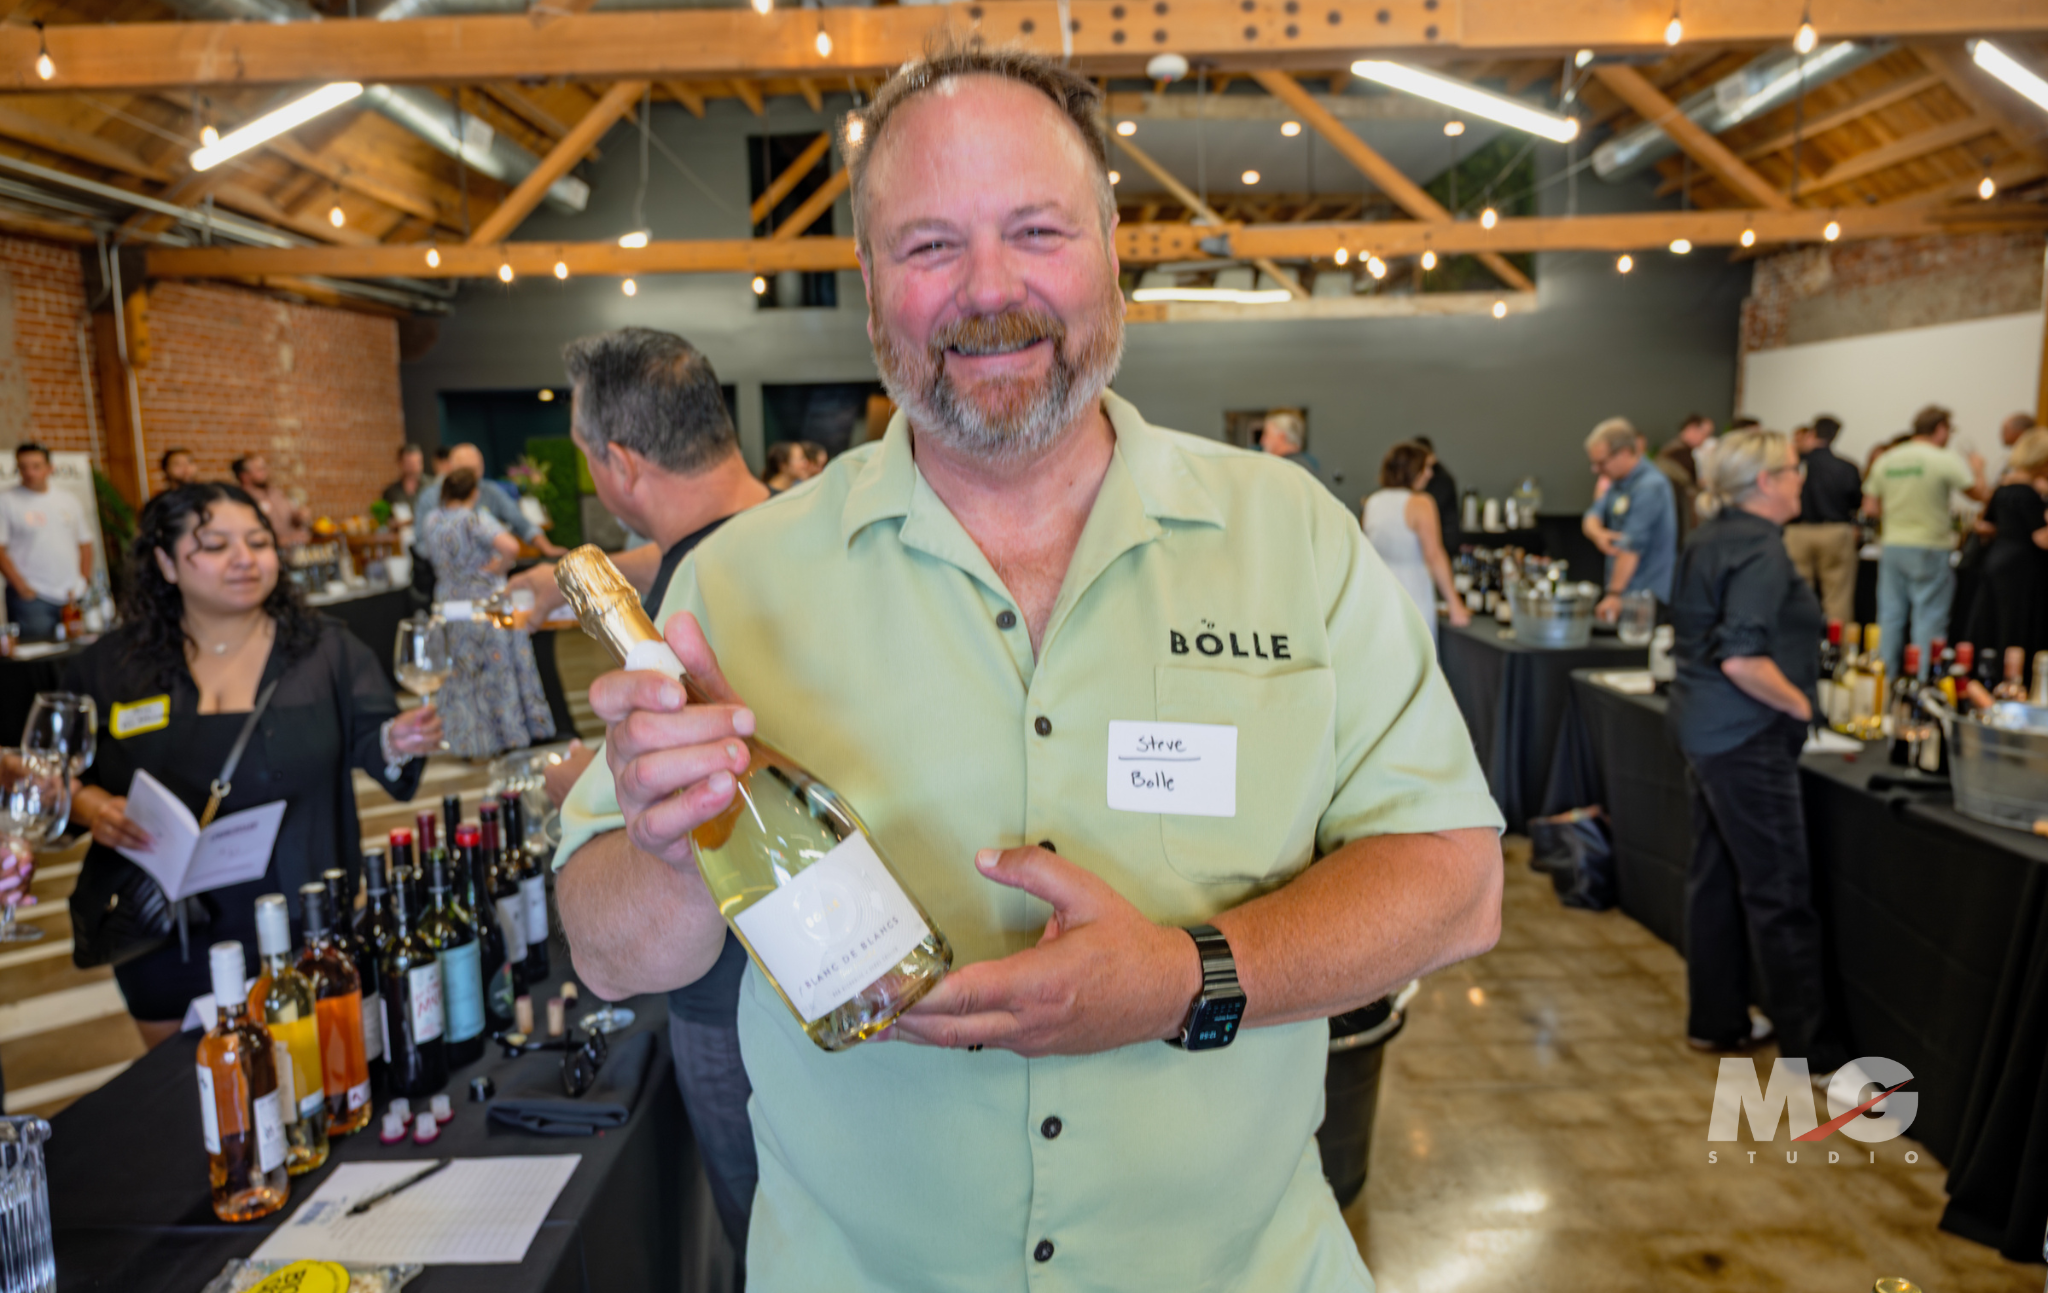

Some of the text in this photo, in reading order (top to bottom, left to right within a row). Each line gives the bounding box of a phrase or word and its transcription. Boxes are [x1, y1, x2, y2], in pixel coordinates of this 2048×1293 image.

[1170, 618, 1292, 660] BÖLLE
[1136, 734, 1187, 753] Steve
[1131, 770, 1175, 791] Bolle
[804, 962, 840, 990] BLANC
[842, 949, 858, 965] DE
[860, 915, 900, 951] BLANCS
